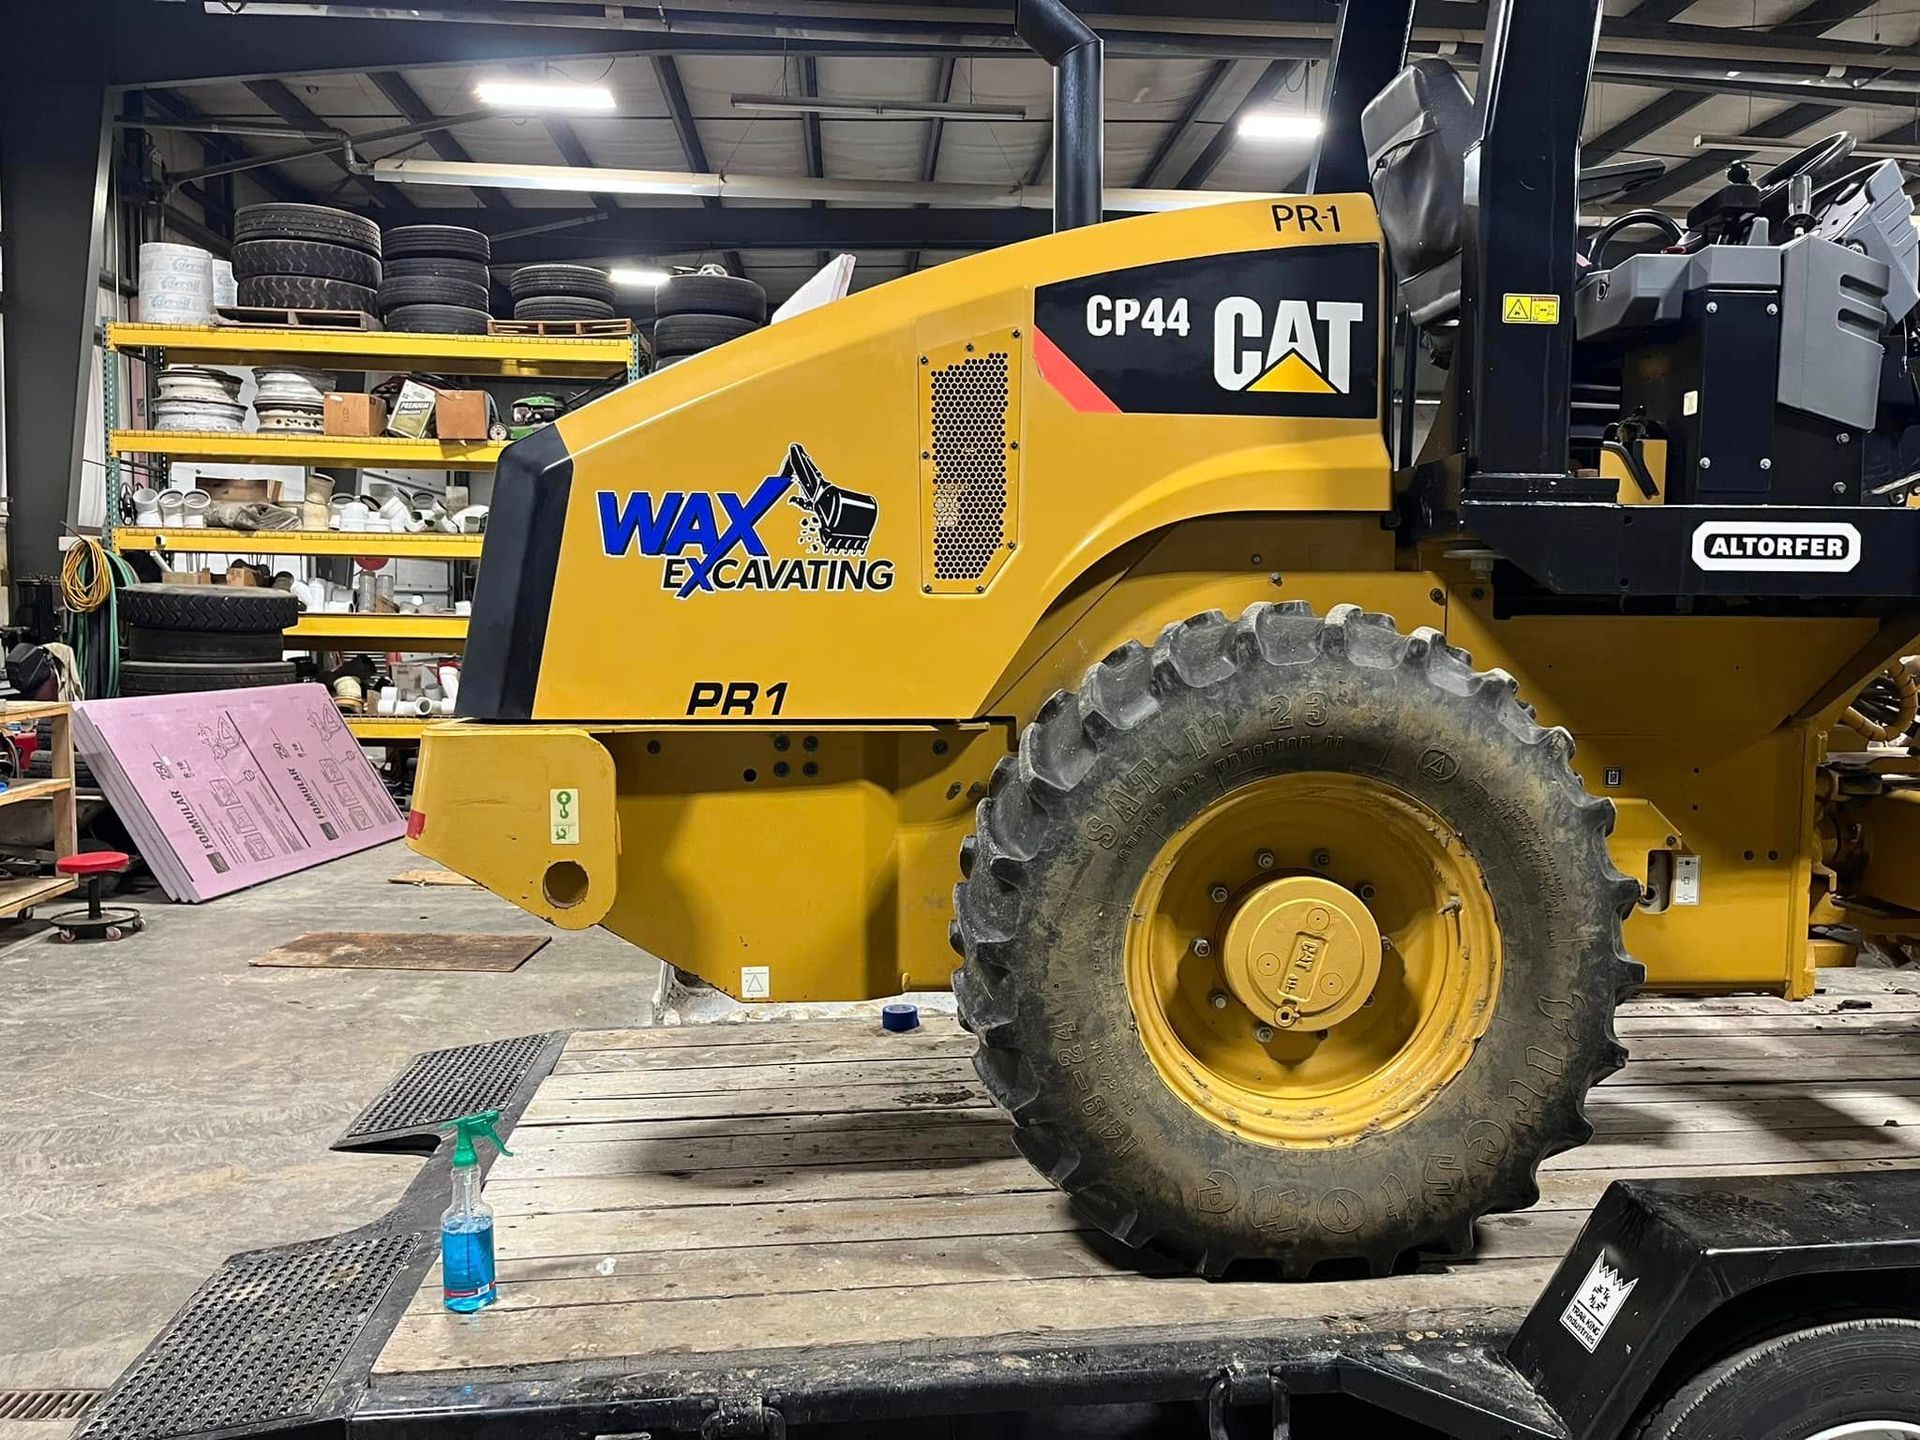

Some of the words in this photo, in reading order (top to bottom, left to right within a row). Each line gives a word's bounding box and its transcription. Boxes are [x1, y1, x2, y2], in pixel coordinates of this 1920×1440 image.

[1271, 204, 1341, 233] PR-1
[1086, 294, 1190, 337] CP44
[1214, 296, 1364, 394] CAT
[597, 476, 793, 557] WAX
[1710, 537, 1843, 556] ALTORFER
[662, 557, 894, 598] EXCAVATING
[685, 682, 788, 716] PR1
[152, 761, 172, 780] 250
[1214, 735, 1313, 770] TRACTION
[288, 767, 326, 820] FOAMULAR
[1084, 758, 1162, 849] SAT
[170, 790, 214, 850] FOAMULAR
